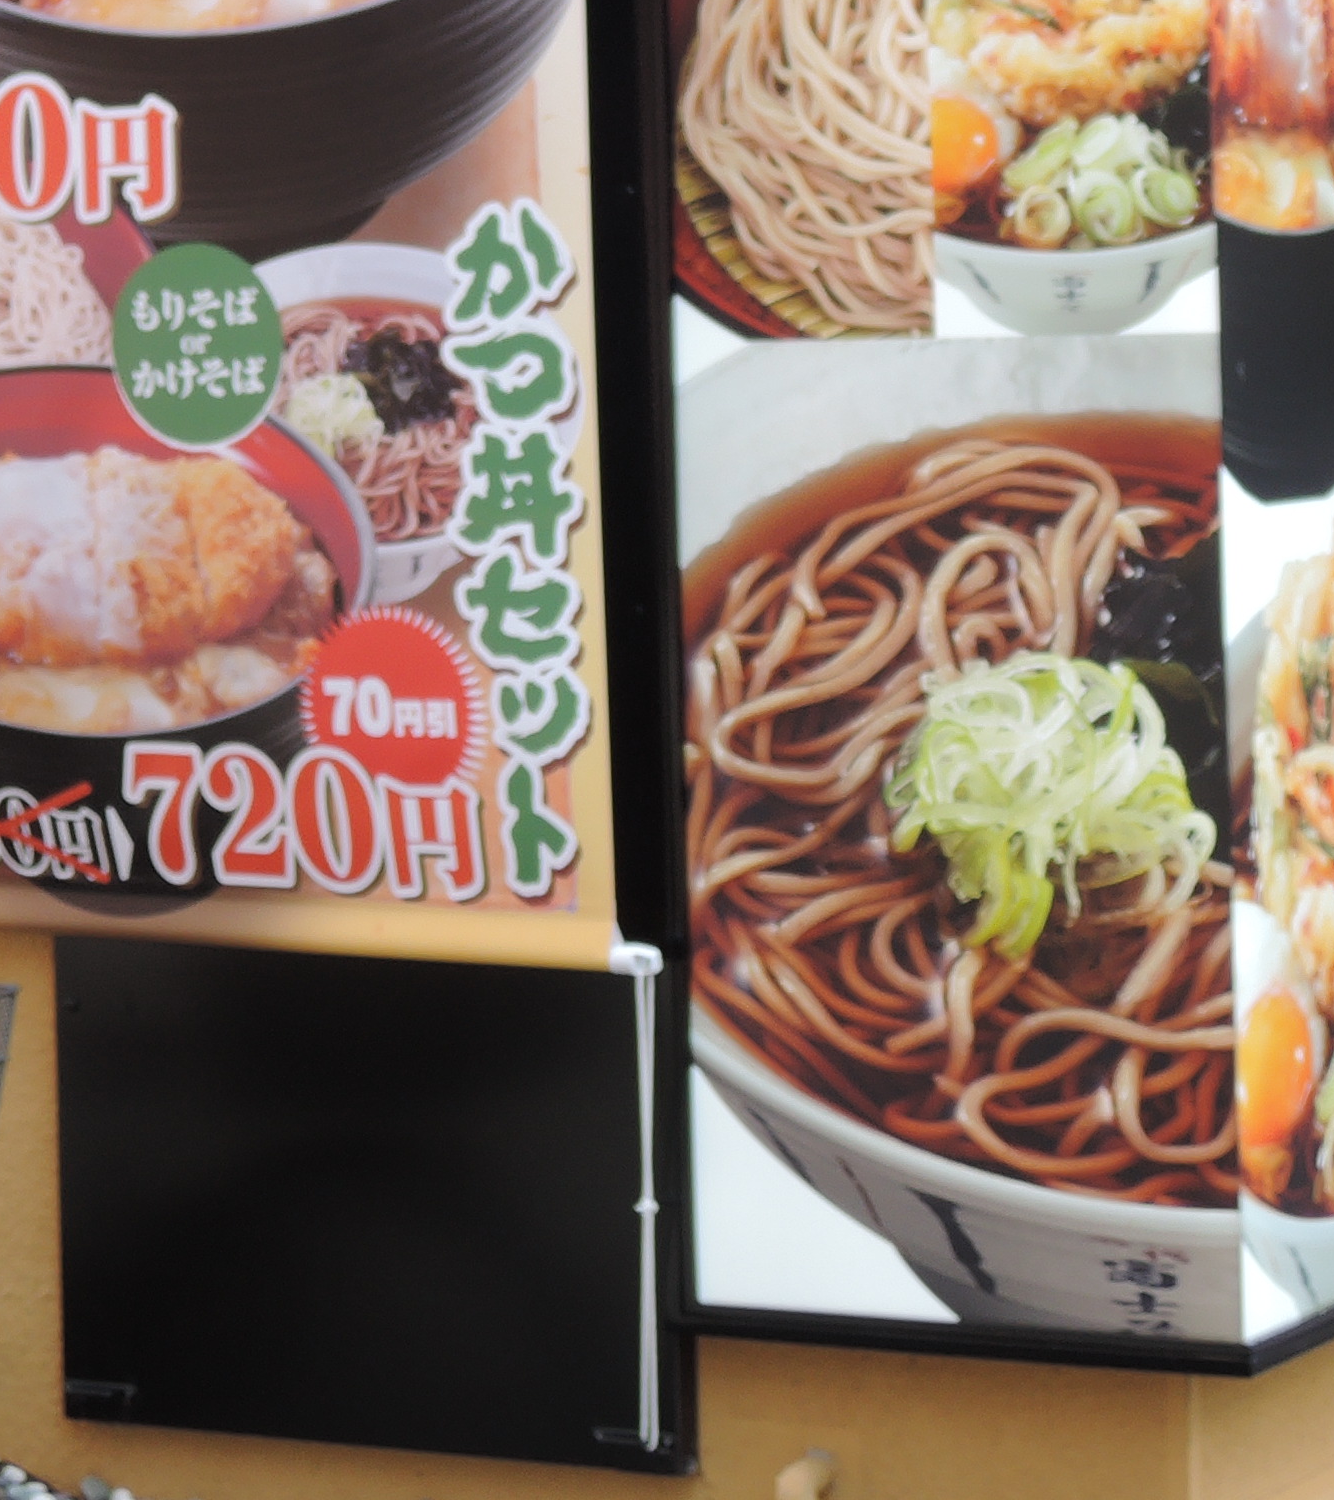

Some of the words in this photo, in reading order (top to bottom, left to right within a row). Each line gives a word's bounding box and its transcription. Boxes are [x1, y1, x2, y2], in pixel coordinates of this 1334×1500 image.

[131, 286, 259, 332] もりそば
[179, 333, 213, 356] or
[131, 357, 267, 399] かけそば
[444, 199, 591, 897] かつ丼セット
[323, 676, 458, 740] 70円引
[123, 740, 486, 899] 720円
